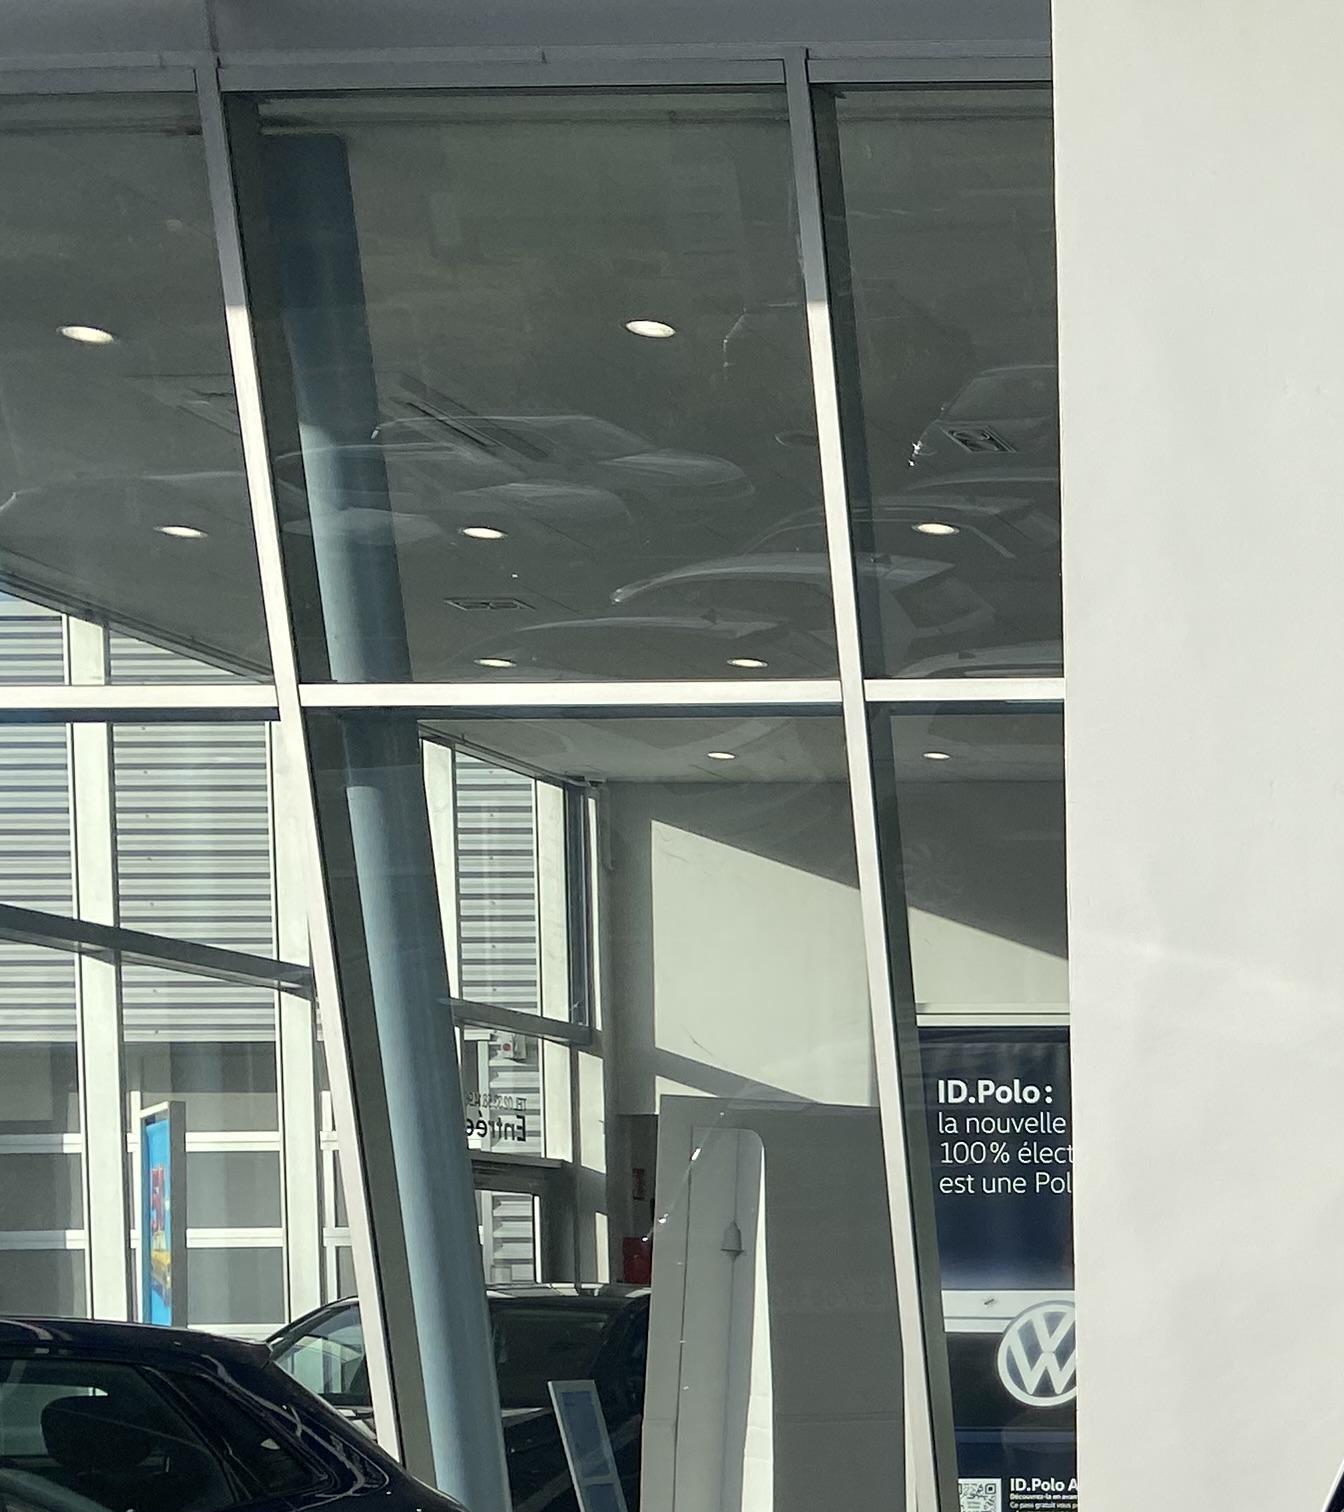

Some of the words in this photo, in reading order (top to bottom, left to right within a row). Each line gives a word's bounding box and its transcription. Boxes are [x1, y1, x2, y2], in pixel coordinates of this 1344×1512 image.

[938, 1111, 959, 1134] la
[966, 1111, 1067, 1134] nouvelle
[939, 1174, 975, 1194] est
[982, 1177, 1027, 1194] une
[1035, 1171, 1072, 1194] Pol
[1010, 1477, 1065, 1492] ID.Polo
